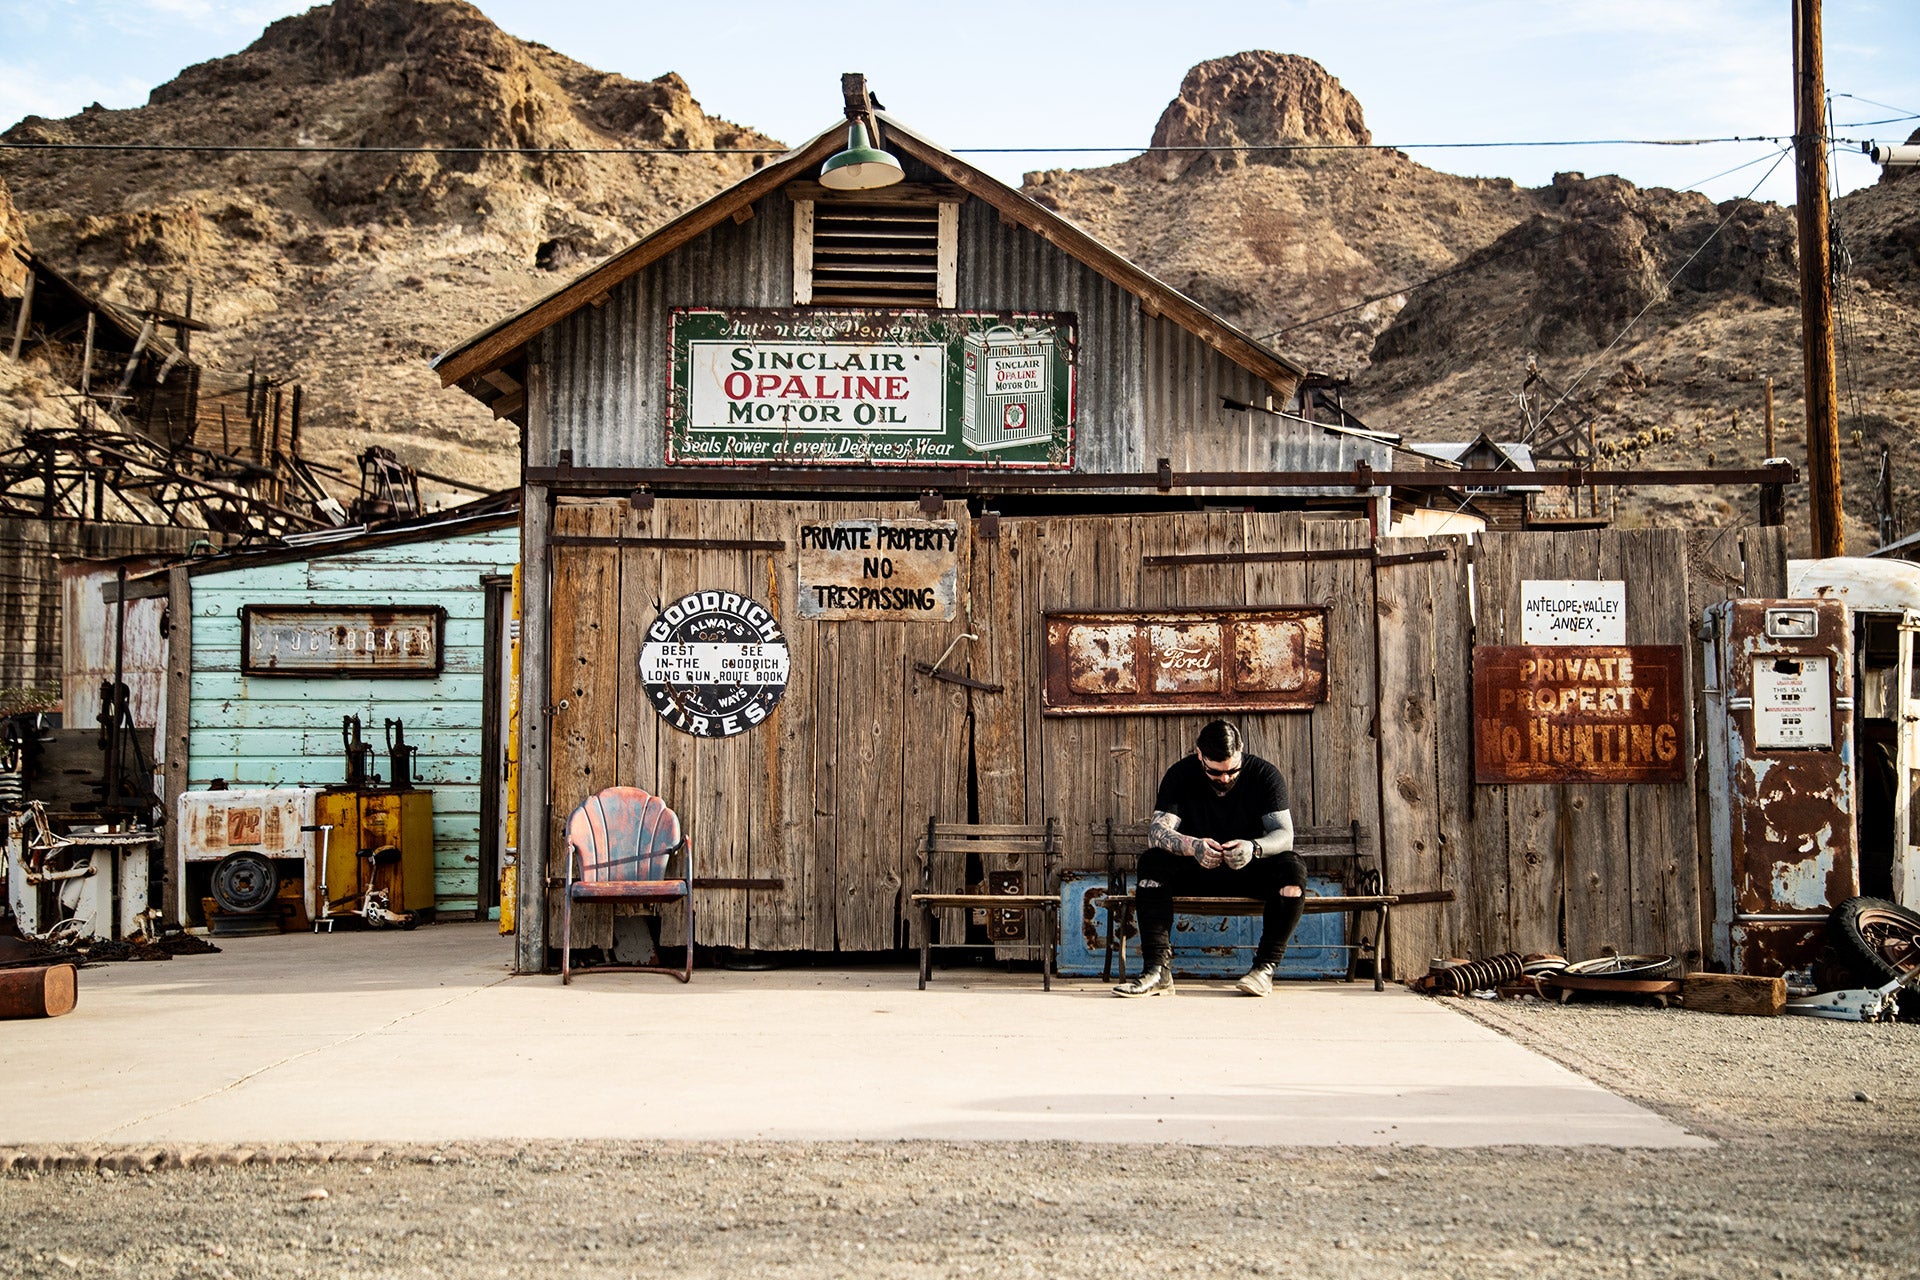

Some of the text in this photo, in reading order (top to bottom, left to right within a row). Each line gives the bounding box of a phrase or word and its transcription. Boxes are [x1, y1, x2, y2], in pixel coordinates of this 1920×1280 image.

[719, 319, 838, 338] Autrized
[731, 347, 907, 373] SINCLAIR
[995, 360, 1040, 371] SINCLAIR
[995, 380, 1039, 391] MOTOR OIL
[997, 370, 1037, 382] OPALINE
[723, 372, 910, 402] OPALINE
[727, 401, 908, 425] MOTOR OIL
[682, 436, 955, 458] Seals Power at every Degree of Wear
[801, 526, 958, 551] PRIVATE PROPERTY
[863, 557, 893, 579] NO
[812, 585, 936, 611] TRESPASSING
[1526, 600, 1619, 613] ANTELOPE VALLEY
[650, 592, 781, 642] GOODRICH
[689, 618, 745, 637] ALWAYS
[1553, 618, 1594, 630] ANNEX
[662, 645, 695, 656] BEST
[741, 646, 763, 656] SEE
[1160, 647, 1211, 669] Ford
[721, 659, 779, 669] GOODRICH
[1518, 658, 1634, 682] PRIVATE
[648, 670, 680, 681] LONG
[719, 671, 783, 681] ROUTE BOOK
[718, 688, 748, 708] WAYS
[1499, 687, 1655, 712] PROPERTY
[659, 696, 766, 735] TIRES
[1482, 717, 1677, 763] NO HUNTING
